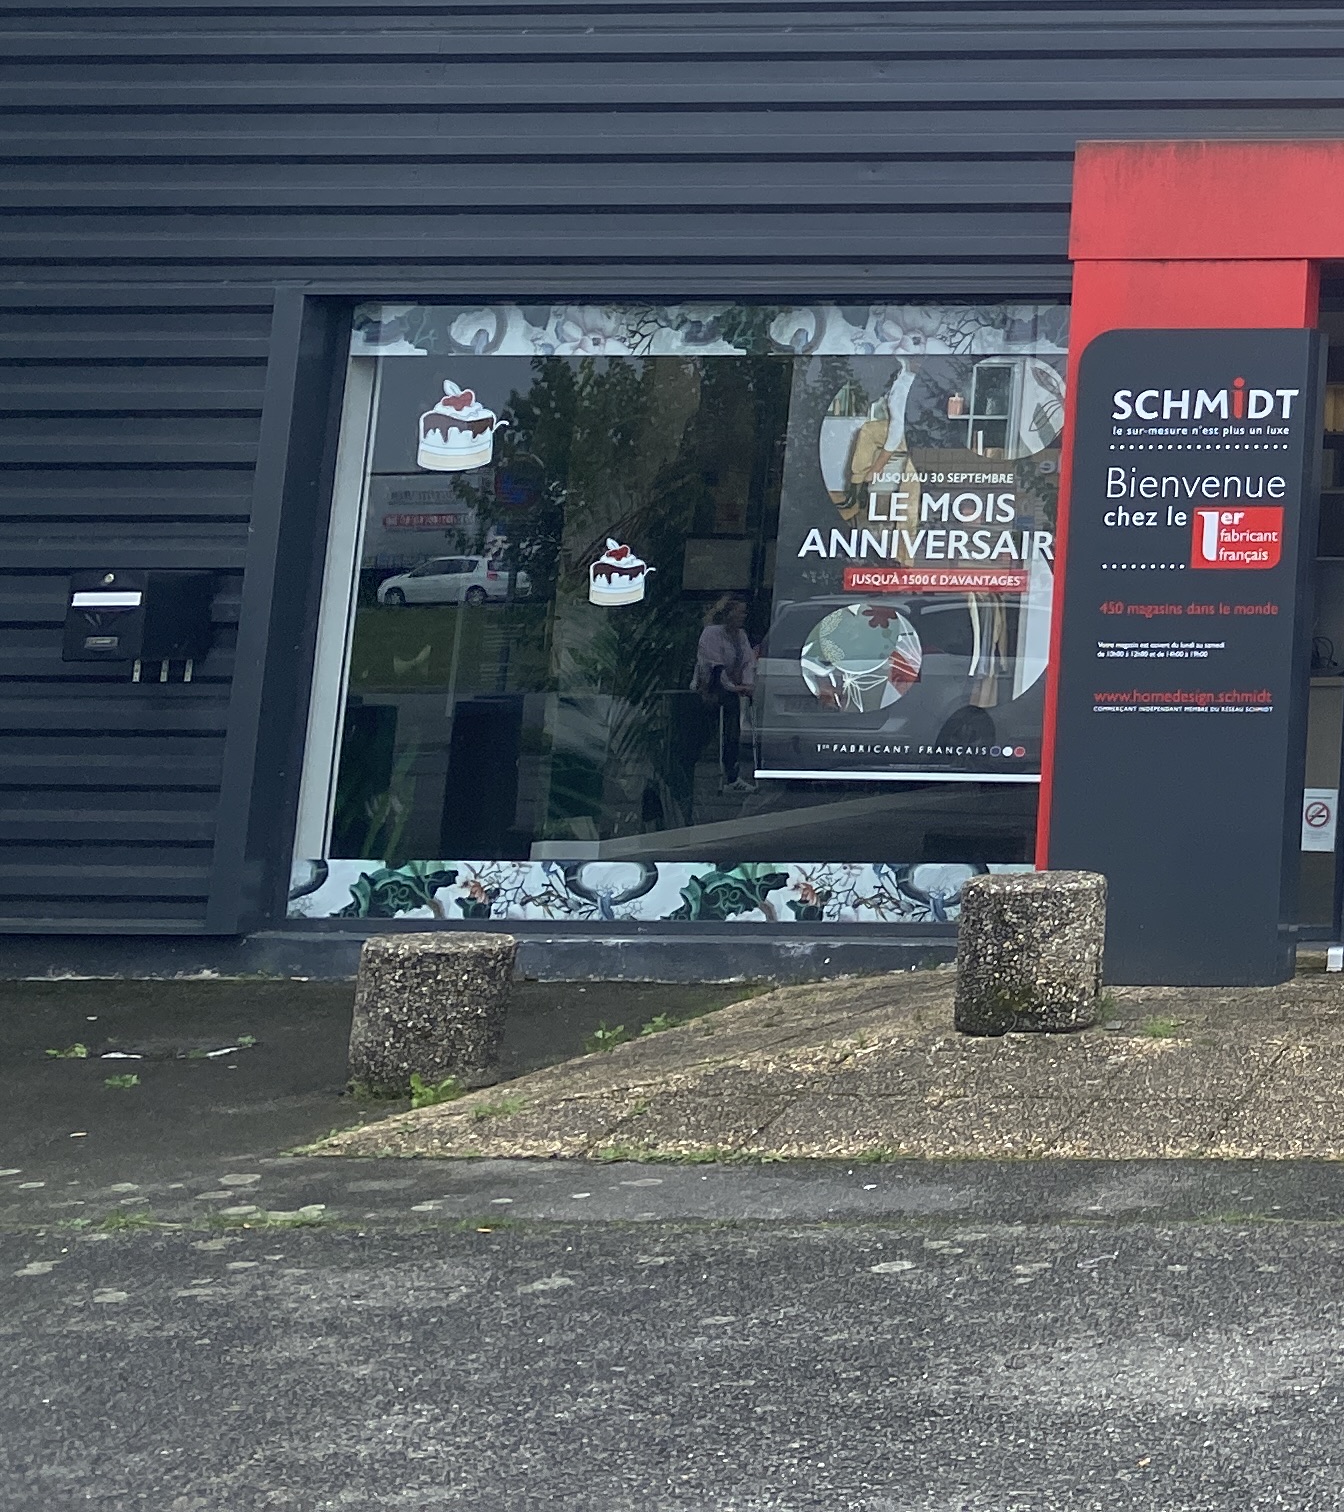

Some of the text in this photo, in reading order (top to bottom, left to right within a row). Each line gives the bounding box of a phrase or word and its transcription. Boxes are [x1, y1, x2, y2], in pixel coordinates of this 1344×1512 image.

[1112, 425, 1290, 437] le sur-mesure n'est plus un luxe
[872, 472, 1014, 484] JUSQU'AU 30 SEPTEMBRE
[1106, 466, 1286, 498] Bienvenue
[868, 492, 1016, 523] LE MOIS
[1104, 506, 1158, 527] chez
[1167, 506, 1187, 527] le
[797, 528, 1055, 561] ANNIVERSAIR
[1219, 530, 1278, 543] fabricant
[1218, 548, 1268, 563] français
[852, 570, 900, 586] JUSQU'À
[1100, 601, 1279, 618] 450 magasins dans le monde
[1093, 688, 1272, 706] www.homedesign.schmidt
[832, 744, 910, 754] FABRICANT
[918, 745, 988, 757] FRANÇAIS
